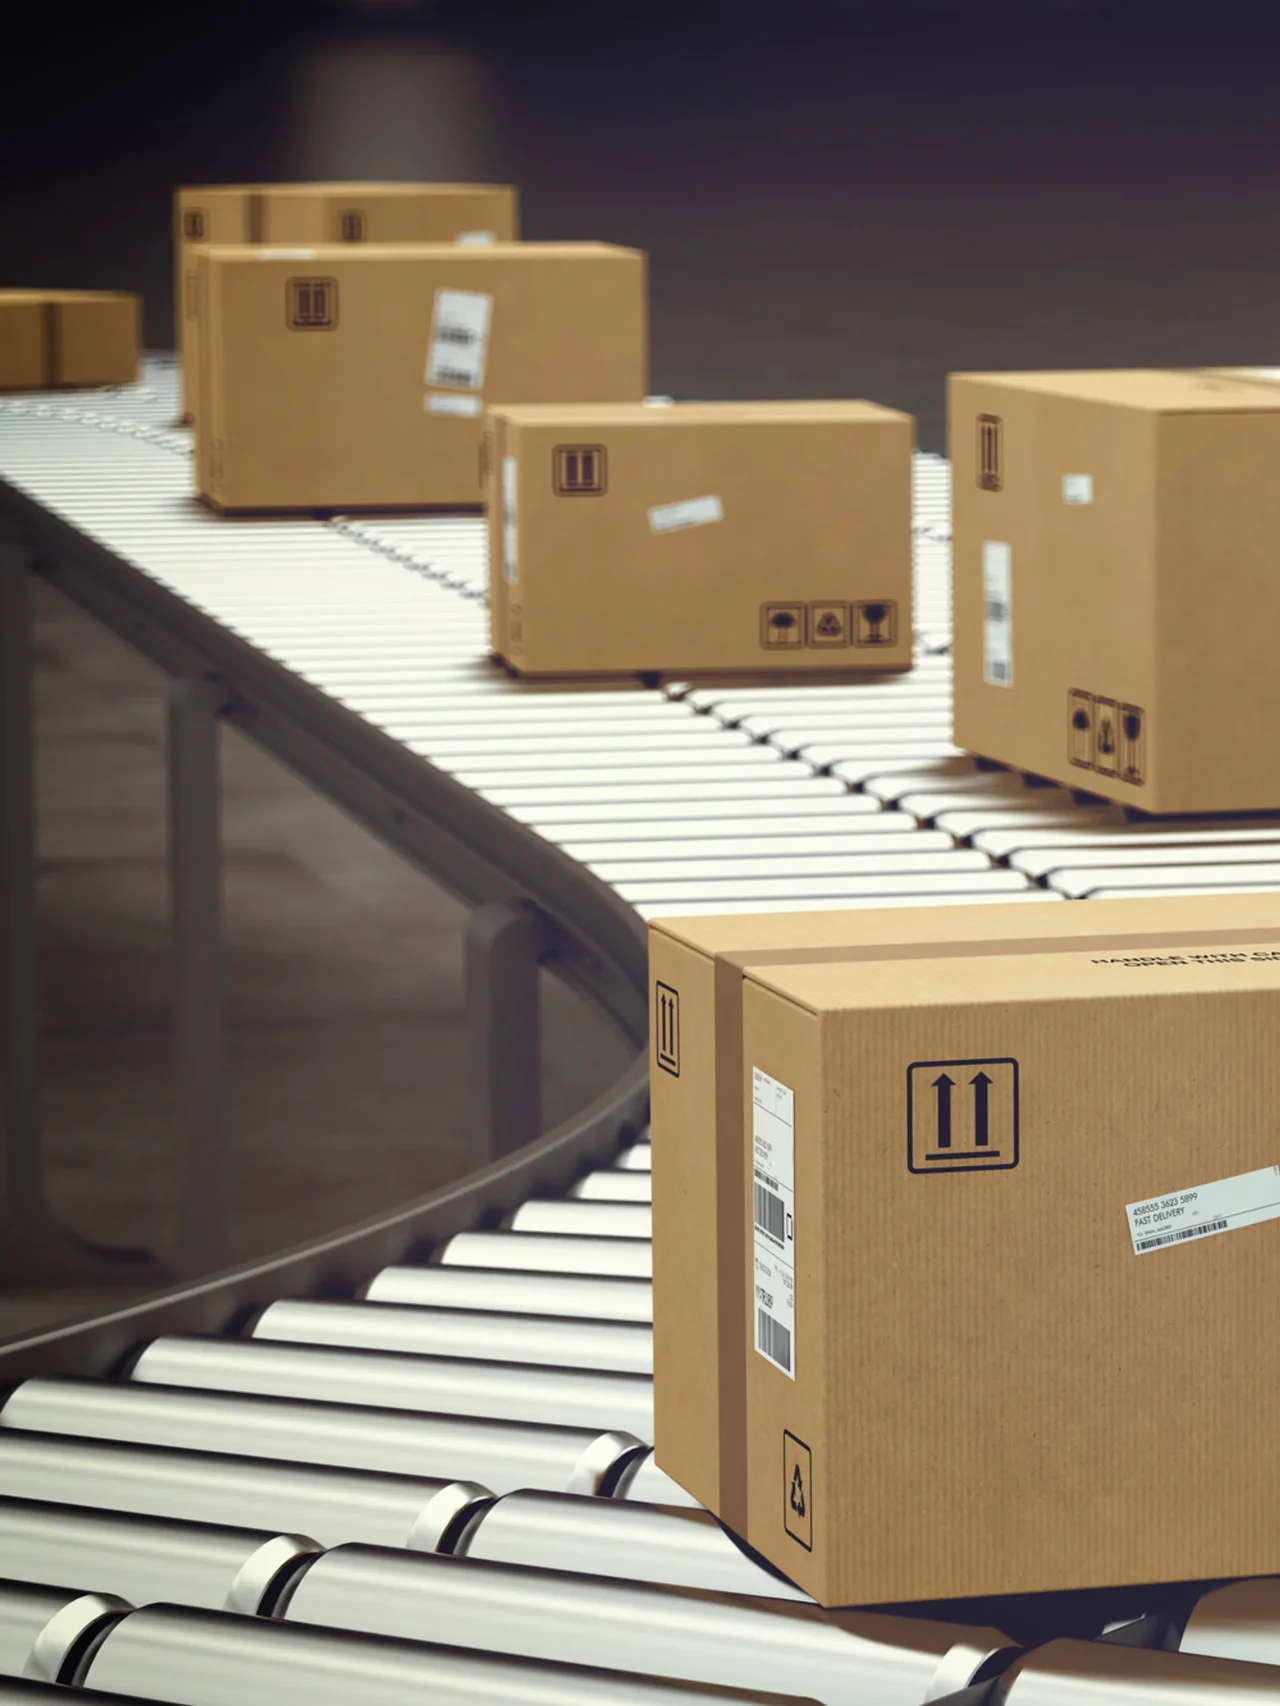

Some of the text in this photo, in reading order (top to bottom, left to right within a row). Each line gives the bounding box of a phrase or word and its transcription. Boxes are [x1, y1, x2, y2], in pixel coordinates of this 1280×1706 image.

[1090, 955, 1185, 964] HANDLE
[1187, 952, 1247, 960] WITH
[1180, 1192, 1198, 1204] 5899
[1134, 1215, 1151, 1227] FAST
[1153, 1206, 1185, 1222] DELIVERY
